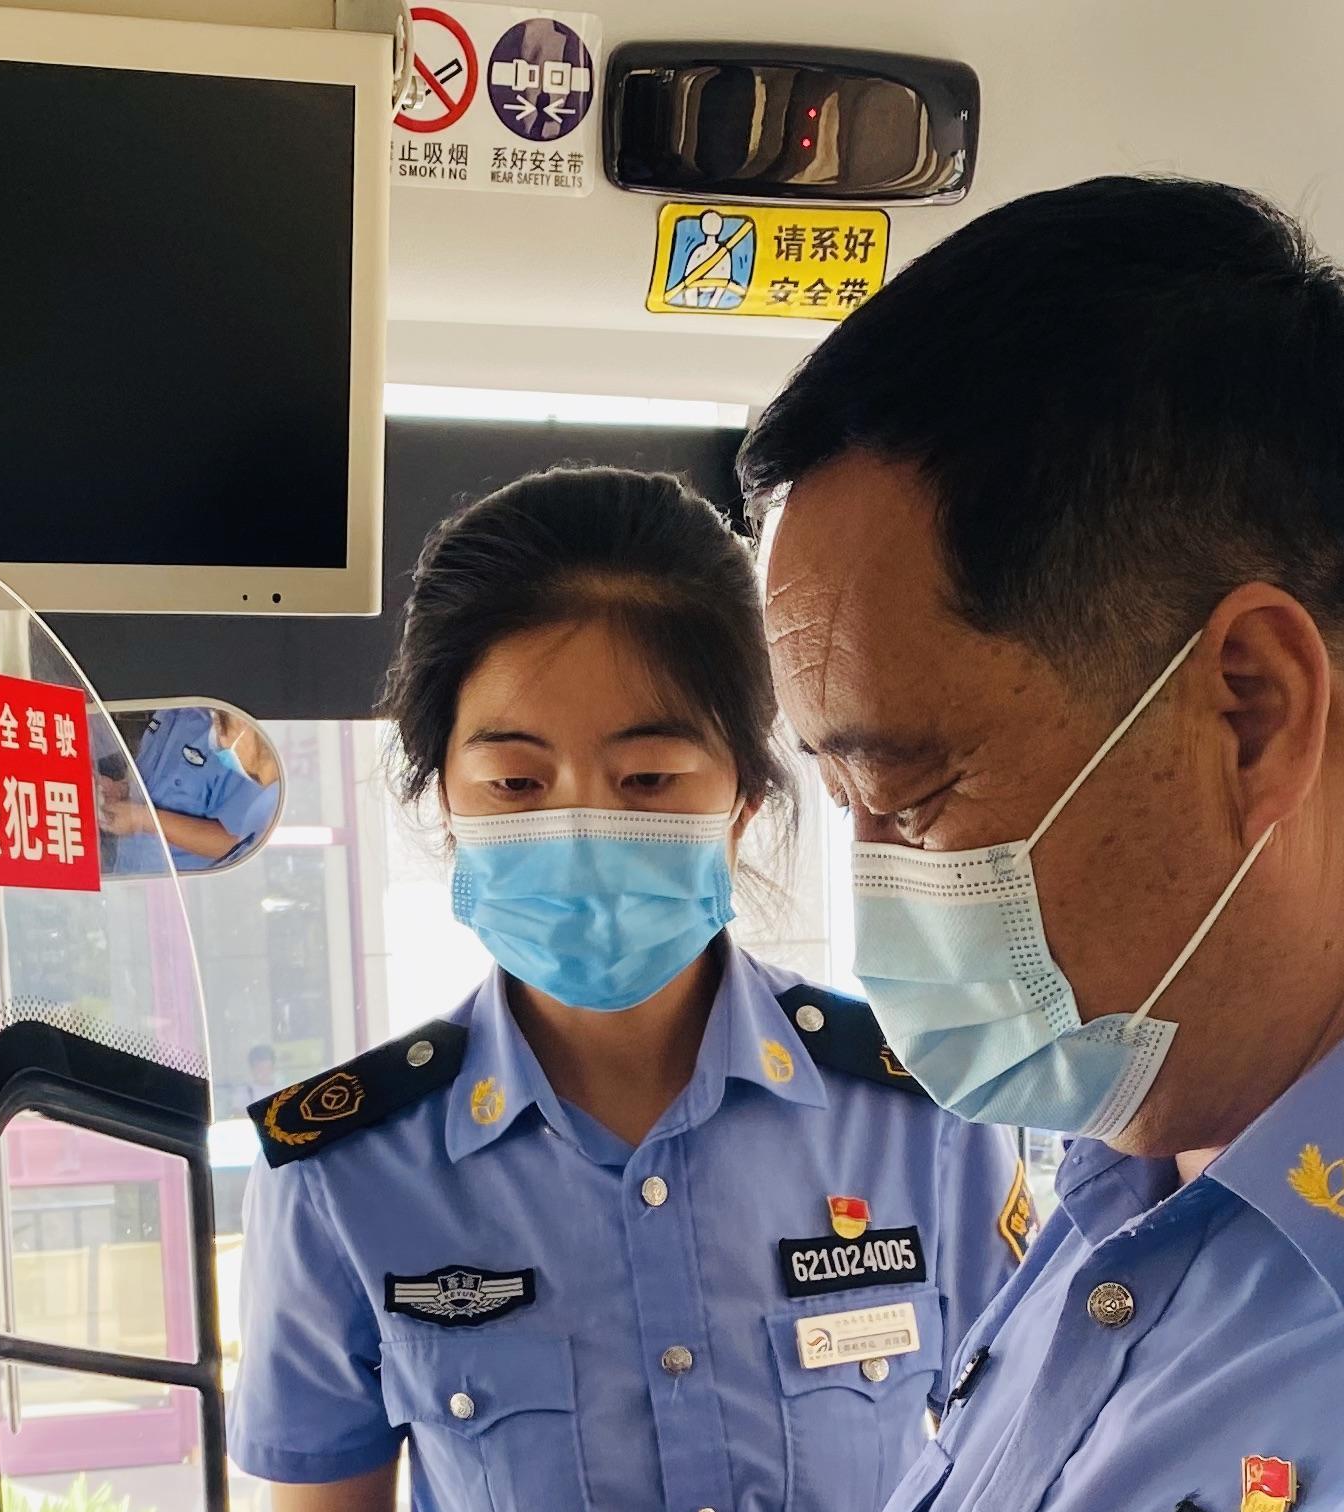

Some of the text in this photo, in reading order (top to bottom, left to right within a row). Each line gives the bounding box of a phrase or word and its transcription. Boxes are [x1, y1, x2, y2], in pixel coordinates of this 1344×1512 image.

[390, 140, 469, 167] 止吸烟
[491, 147, 585, 174] 系好安全带
[398, 164, 468, 181] SMOKING
[490, 170, 583, 189] WEAR SAFETY BELTS
[773, 224, 876, 263] 请系好
[766, 276, 870, 309] 安全带
[791, 1239, 917, 1282] 621024005
